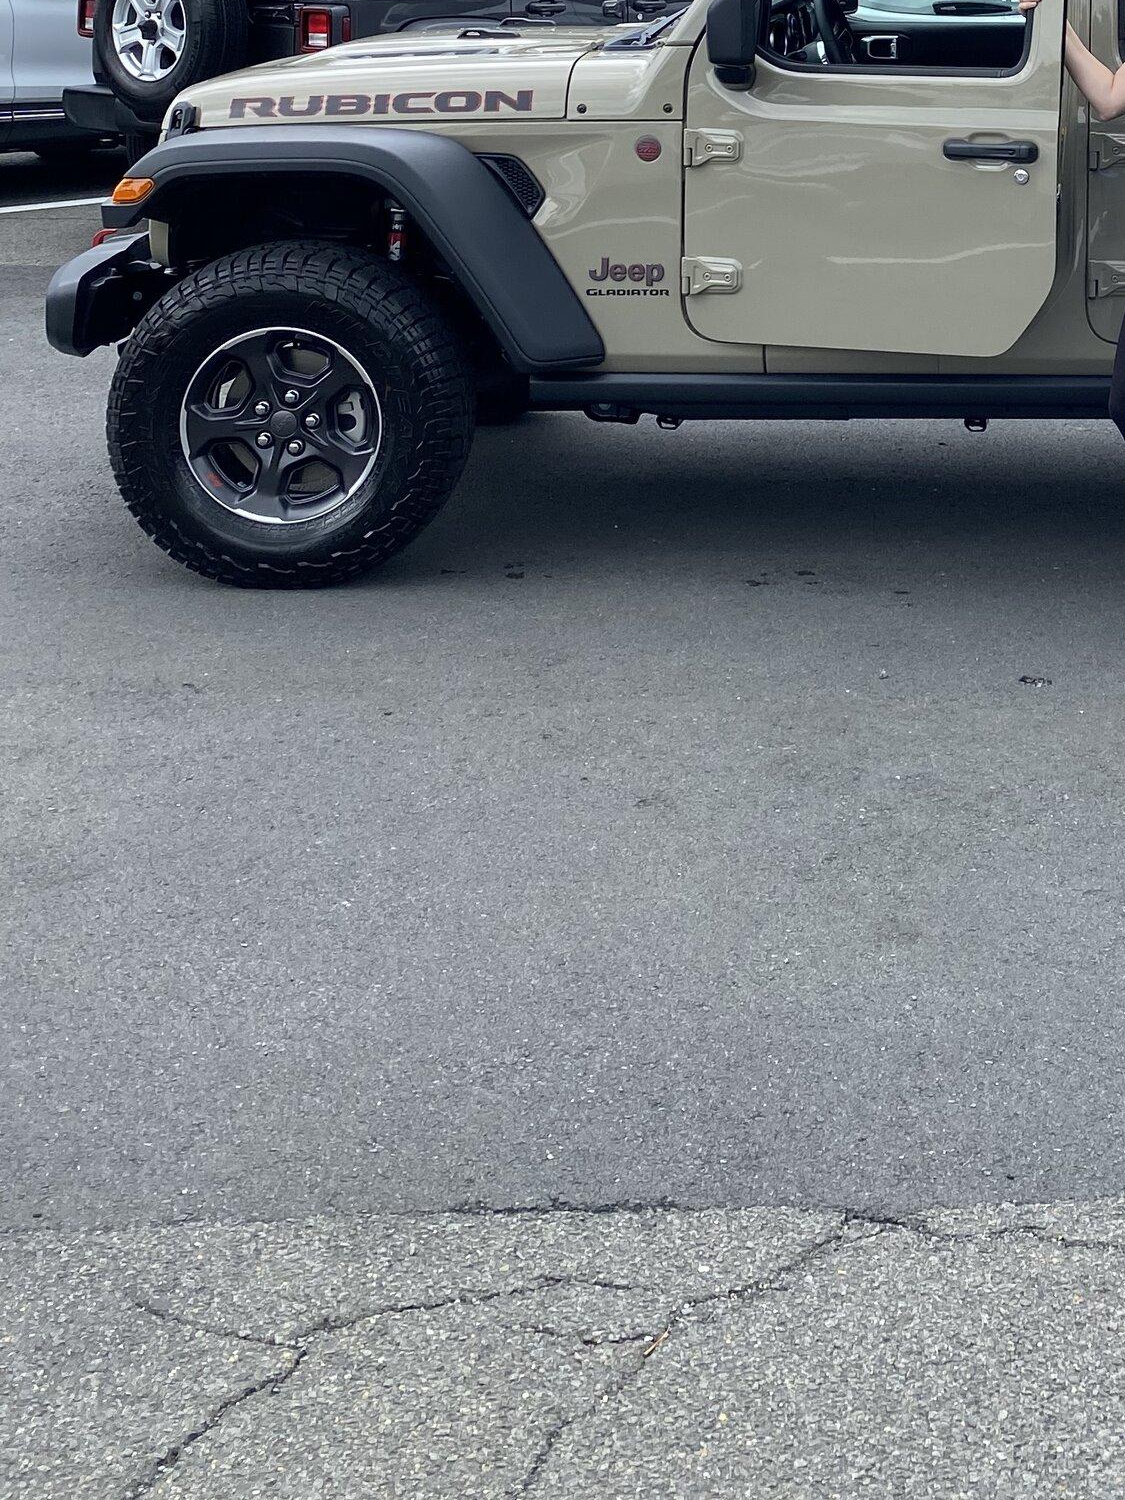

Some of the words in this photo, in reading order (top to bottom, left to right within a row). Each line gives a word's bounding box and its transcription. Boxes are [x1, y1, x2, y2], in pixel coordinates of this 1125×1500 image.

[228, 89, 534, 118] RUBICON
[588, 256, 665, 287] Jeep
[586, 288, 670, 297] GLADIATOR
